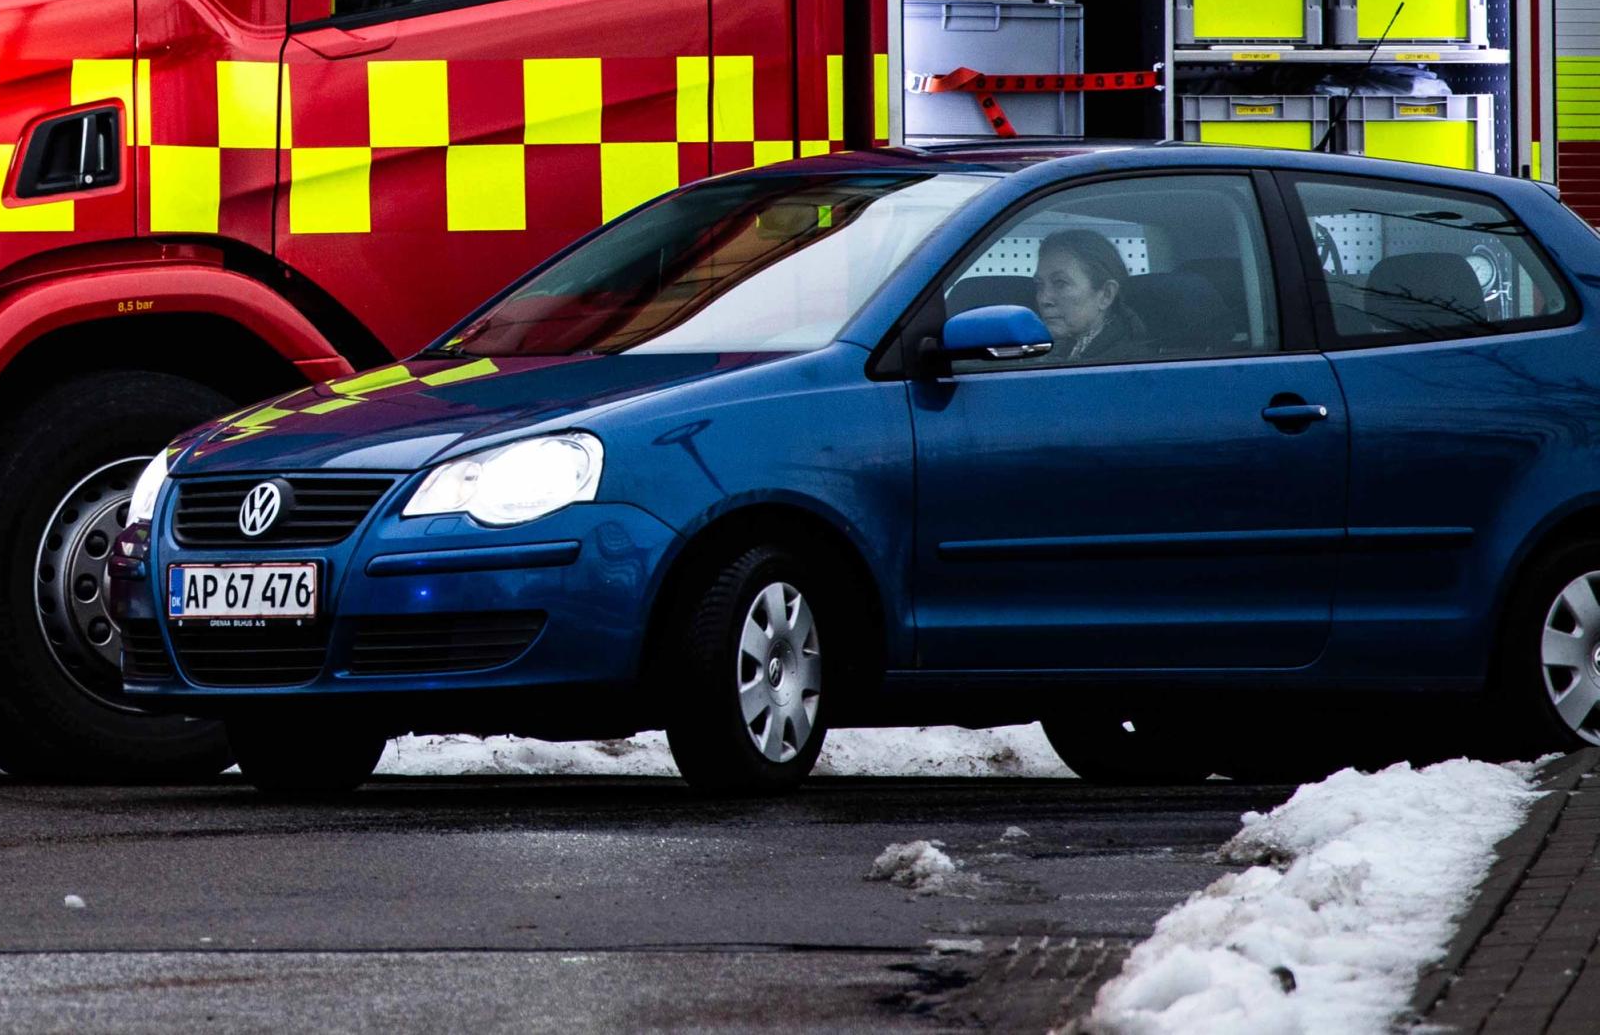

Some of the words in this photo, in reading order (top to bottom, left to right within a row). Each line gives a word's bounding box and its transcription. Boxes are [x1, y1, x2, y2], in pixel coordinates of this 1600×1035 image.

[117, 301, 134, 312] 8,5
[136, 299, 154, 310] bar
[185, 574, 218, 609] AP
[225, 572, 254, 608] 67
[261, 571, 312, 608] 476
